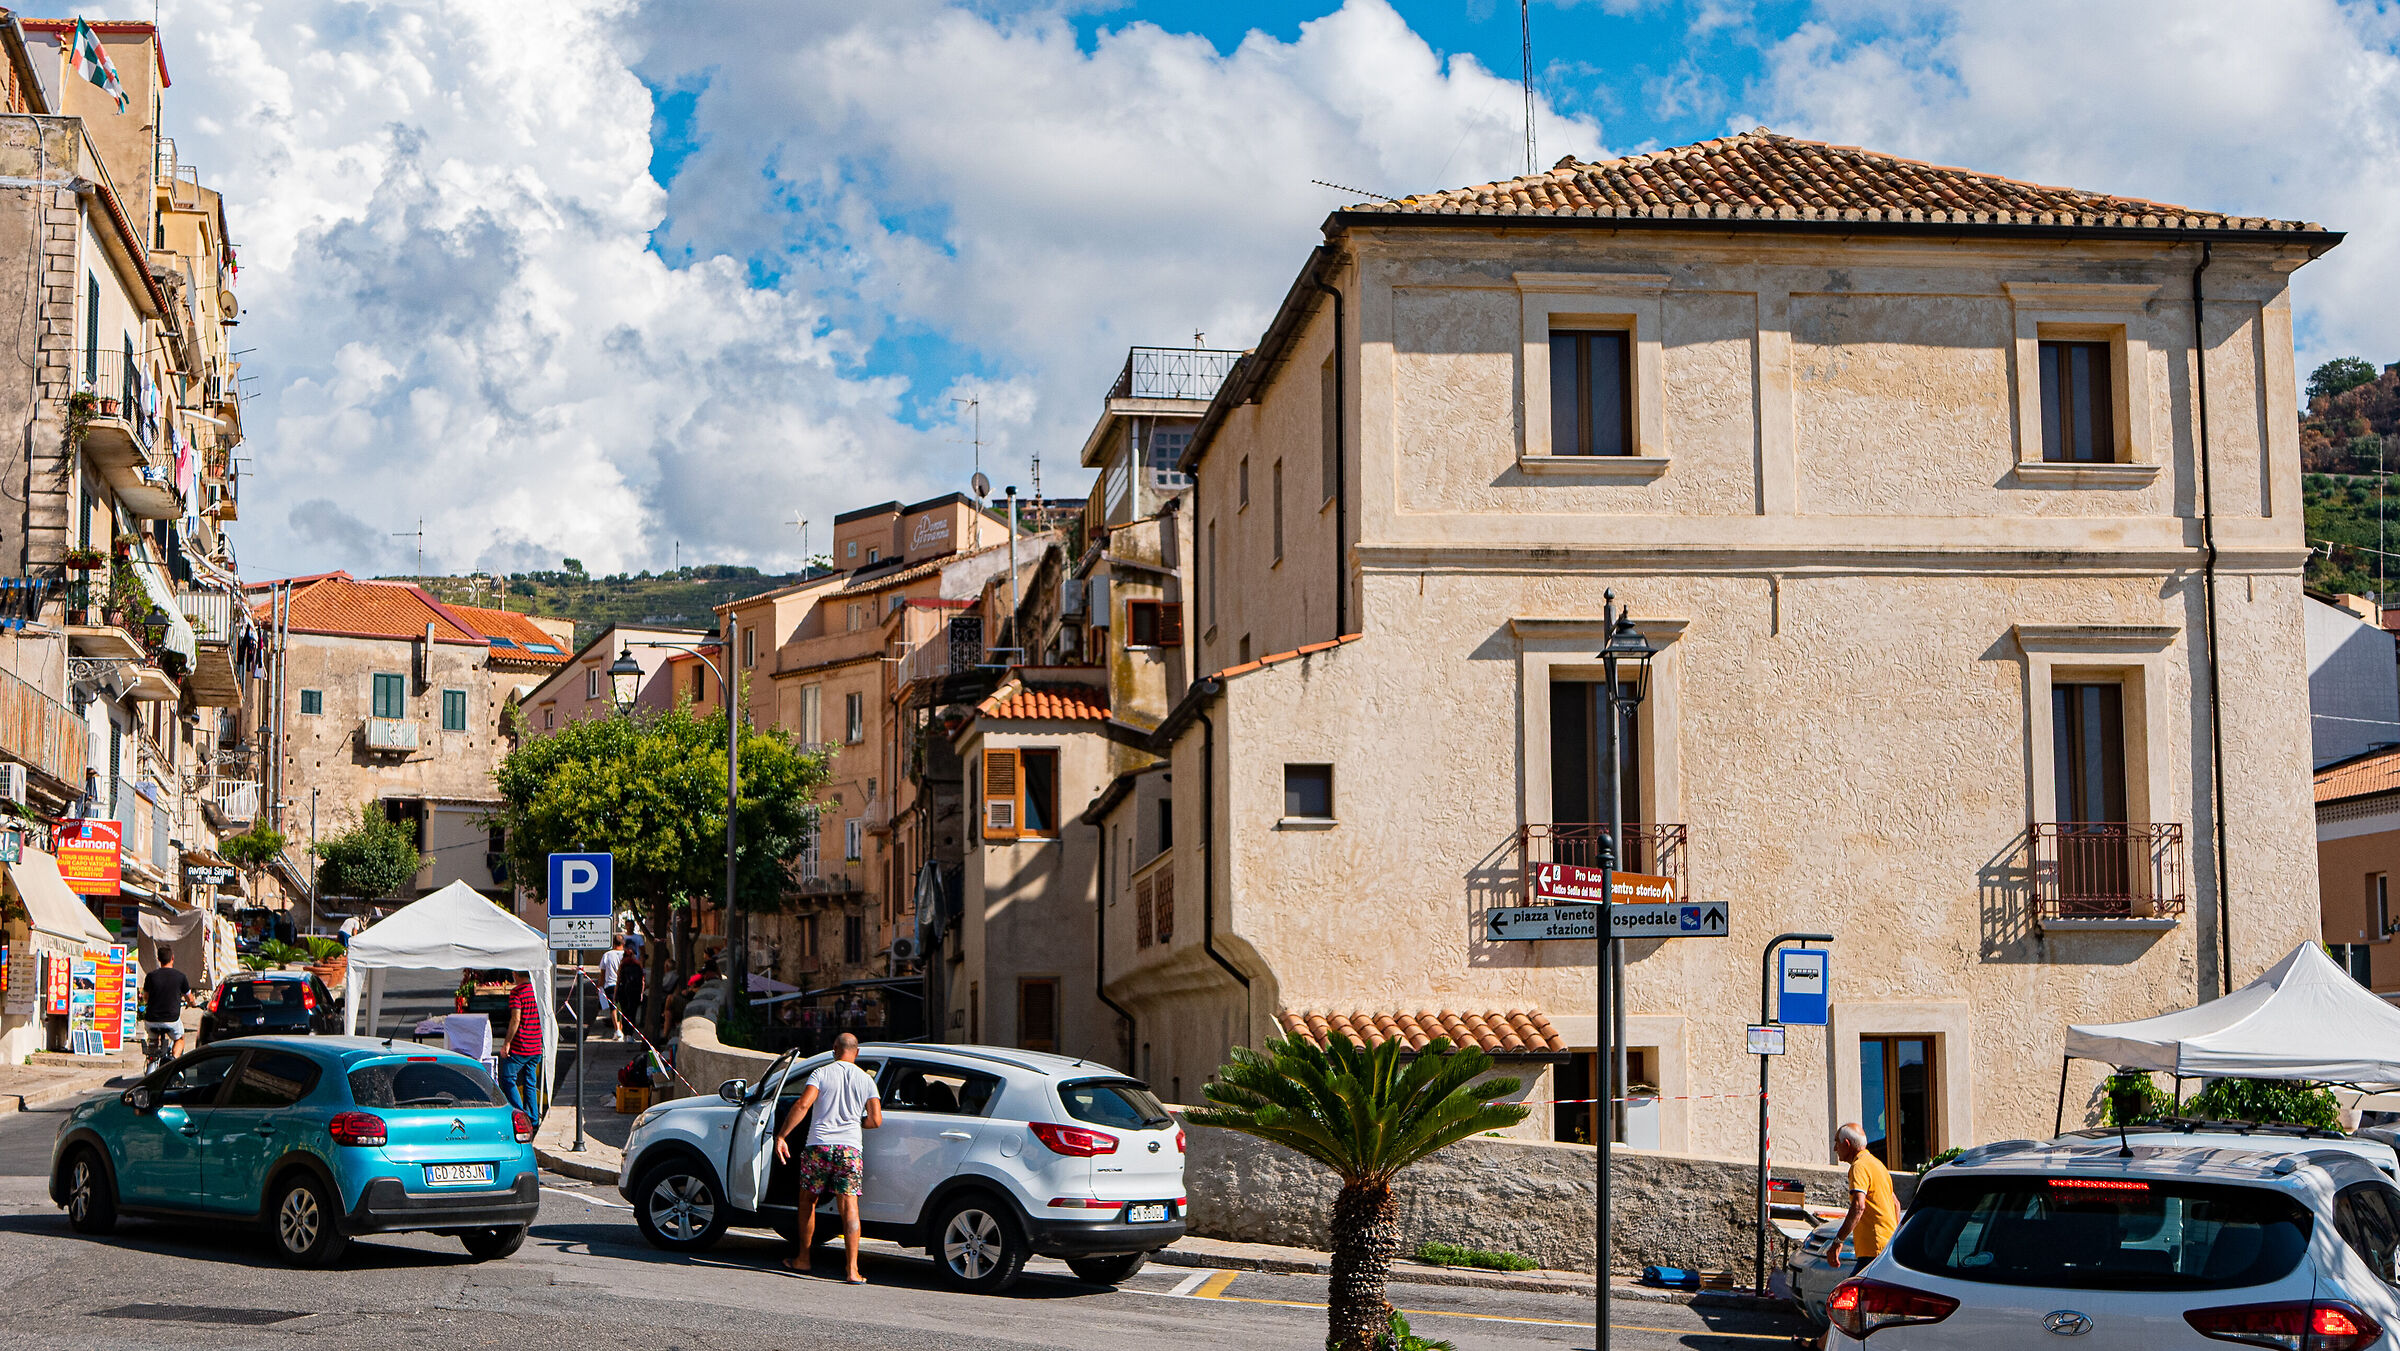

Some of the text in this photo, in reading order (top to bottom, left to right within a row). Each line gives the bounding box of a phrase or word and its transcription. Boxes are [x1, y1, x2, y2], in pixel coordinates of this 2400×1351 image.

[67, 836, 116, 850] Cannone
[1575, 869, 1602, 883] Pro Loco
[562, 860, 599, 910] P
[1636, 883, 1661, 898] storico
[1513, 908, 1595, 924] piazza Veneto
[1613, 910, 1677, 928] ospedale
[1546, 923, 1595, 935] stazione
[434, 1165, 485, 1180] GD 283JN
